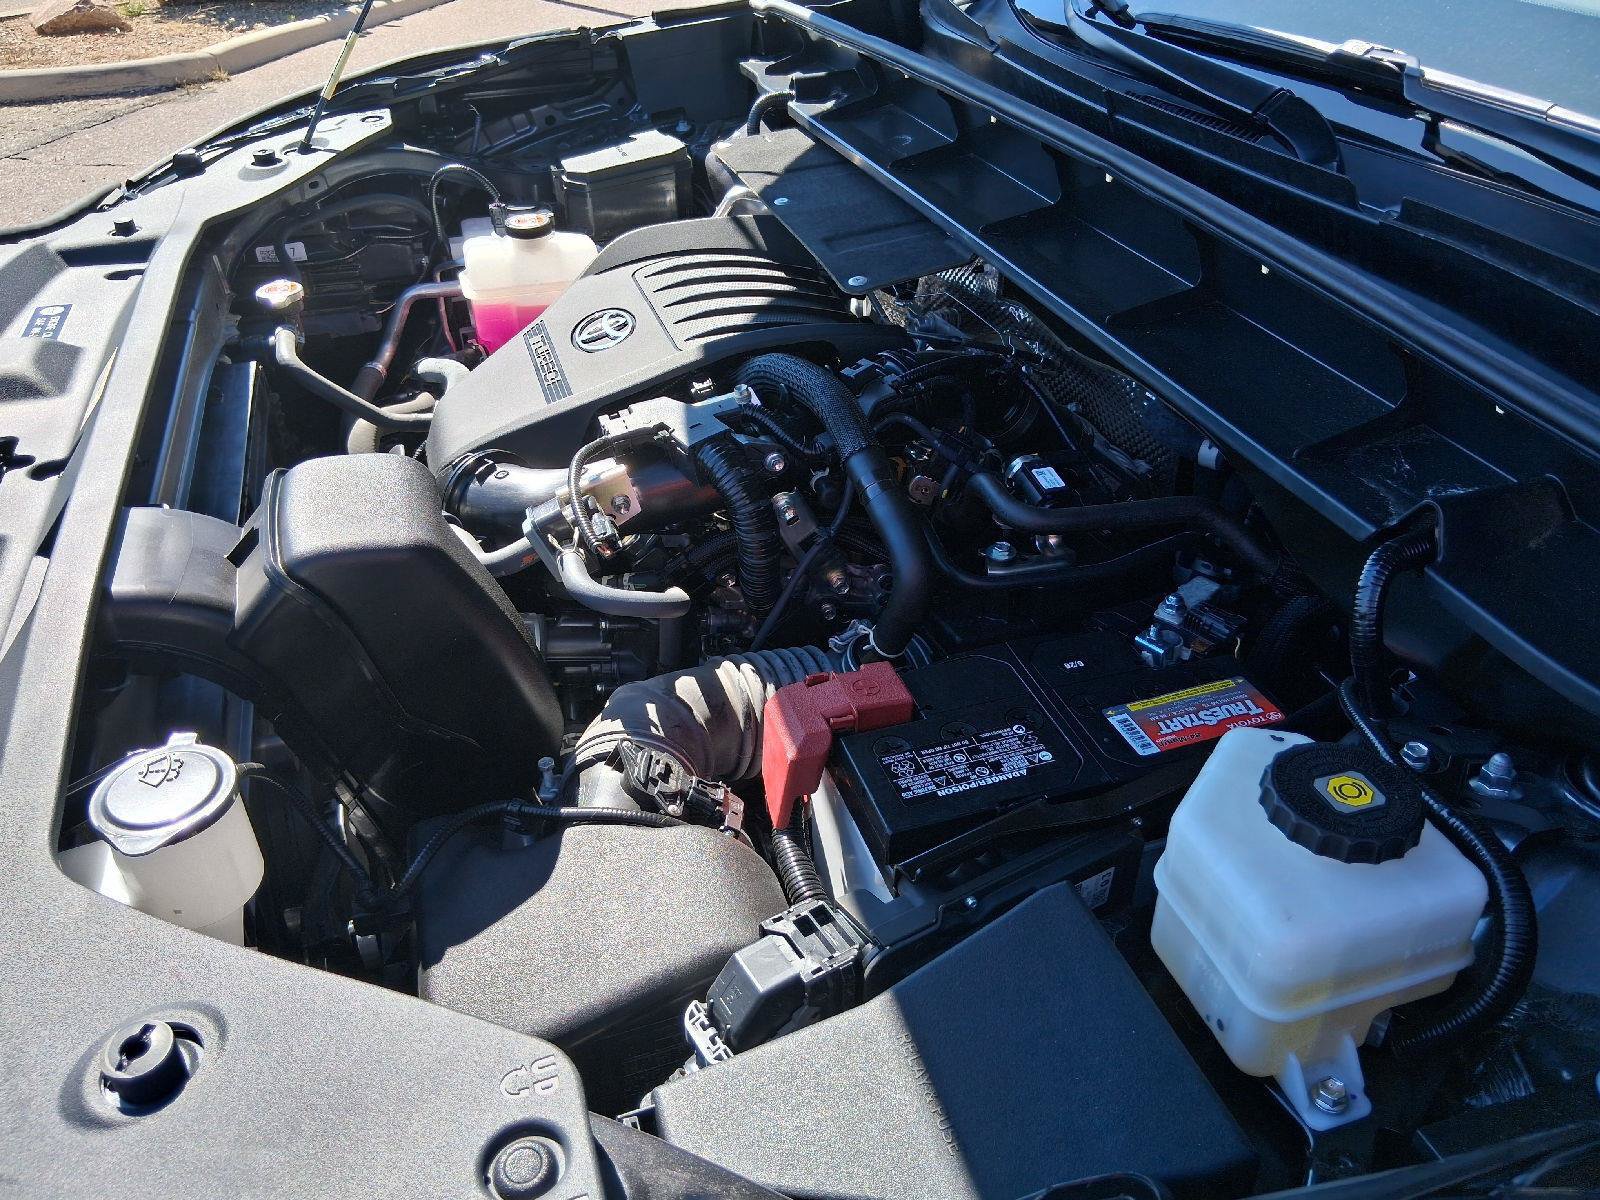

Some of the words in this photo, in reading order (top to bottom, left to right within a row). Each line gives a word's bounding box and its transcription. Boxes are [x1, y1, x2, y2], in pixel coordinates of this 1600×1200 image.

[529, 333, 561, 386] TURBO
[1225, 715, 1266, 730] TOYOTA
[936, 770, 1021, 797] DANGER/POISON
